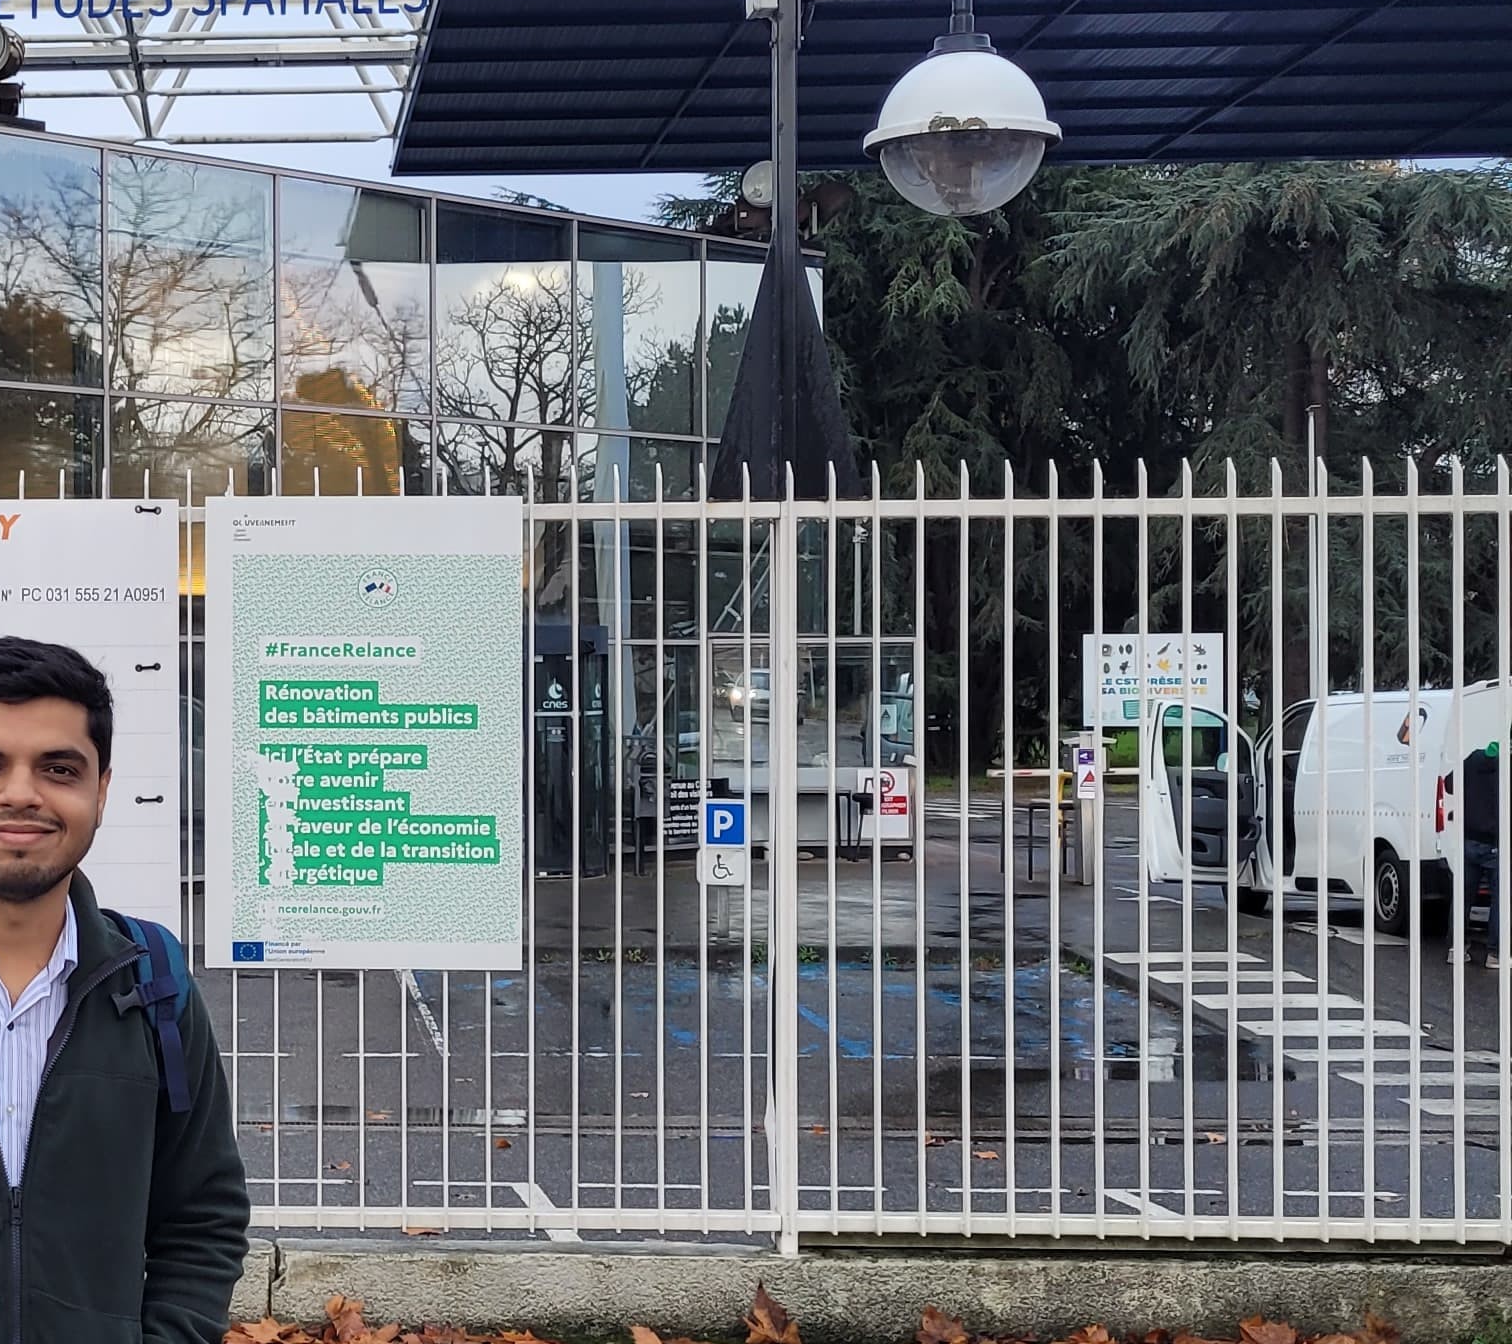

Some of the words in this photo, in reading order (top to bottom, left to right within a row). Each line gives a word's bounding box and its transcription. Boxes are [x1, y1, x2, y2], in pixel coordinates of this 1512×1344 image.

[21, 588, 41, 601] PC
[46, 588, 69, 601] 031
[75, 588, 100, 601] 555
[103, 588, 119, 601] 21
[124, 588, 166, 601] A0951
[265, 643, 416, 657] #FranceRelance
[265, 683, 373, 700] Rénovation
[265, 708, 298, 723] des
[303, 707, 399, 724] bâtiments
[405, 708, 473, 728] publics
[349, 748, 422, 769] prépare
[320, 772, 378, 787] avenir
[293, 795, 405, 811] investissant
[358, 818, 382, 834] de
[387, 818, 491, 835] l'économie
[713, 810, 734, 838] P
[326, 843, 346, 857] et
[351, 842, 375, 858] de
[380, 842, 397, 858] la
[402, 842, 495, 859] transition
